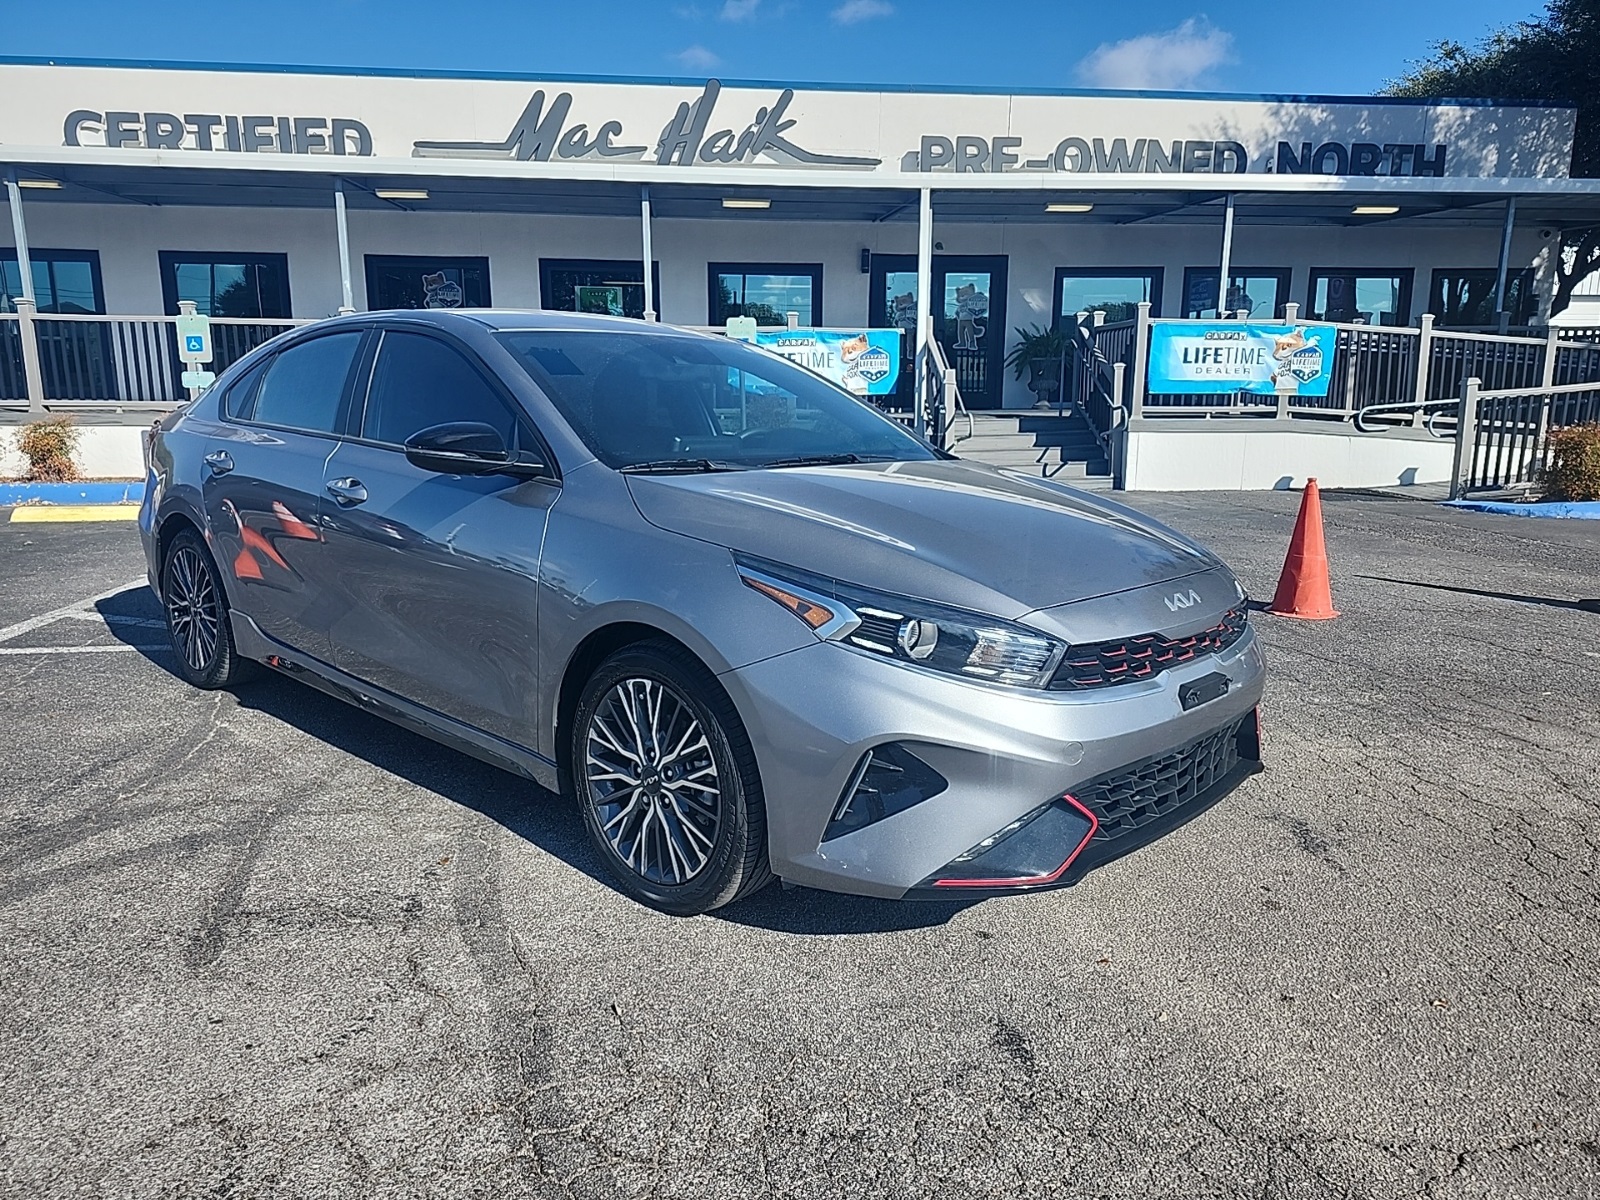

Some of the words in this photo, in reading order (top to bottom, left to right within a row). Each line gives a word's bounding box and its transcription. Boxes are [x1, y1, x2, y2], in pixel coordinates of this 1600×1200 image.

[413, 90, 648, 162] Mac
[656, 78, 882, 166] Haik
[63, 109, 374, 157] CERTIFIED
[919, 135, 1249, 173] PRE-OWNED
[1276, 140, 1448, 177] NORTH
[777, 338, 816, 347] CARFAX
[1204, 332, 1247, 341] CARFAX
[1182, 347, 1266, 365] LIFETIME
[1195, 367, 1251, 375] DEALER
[1163, 589, 1202, 612] KIA
